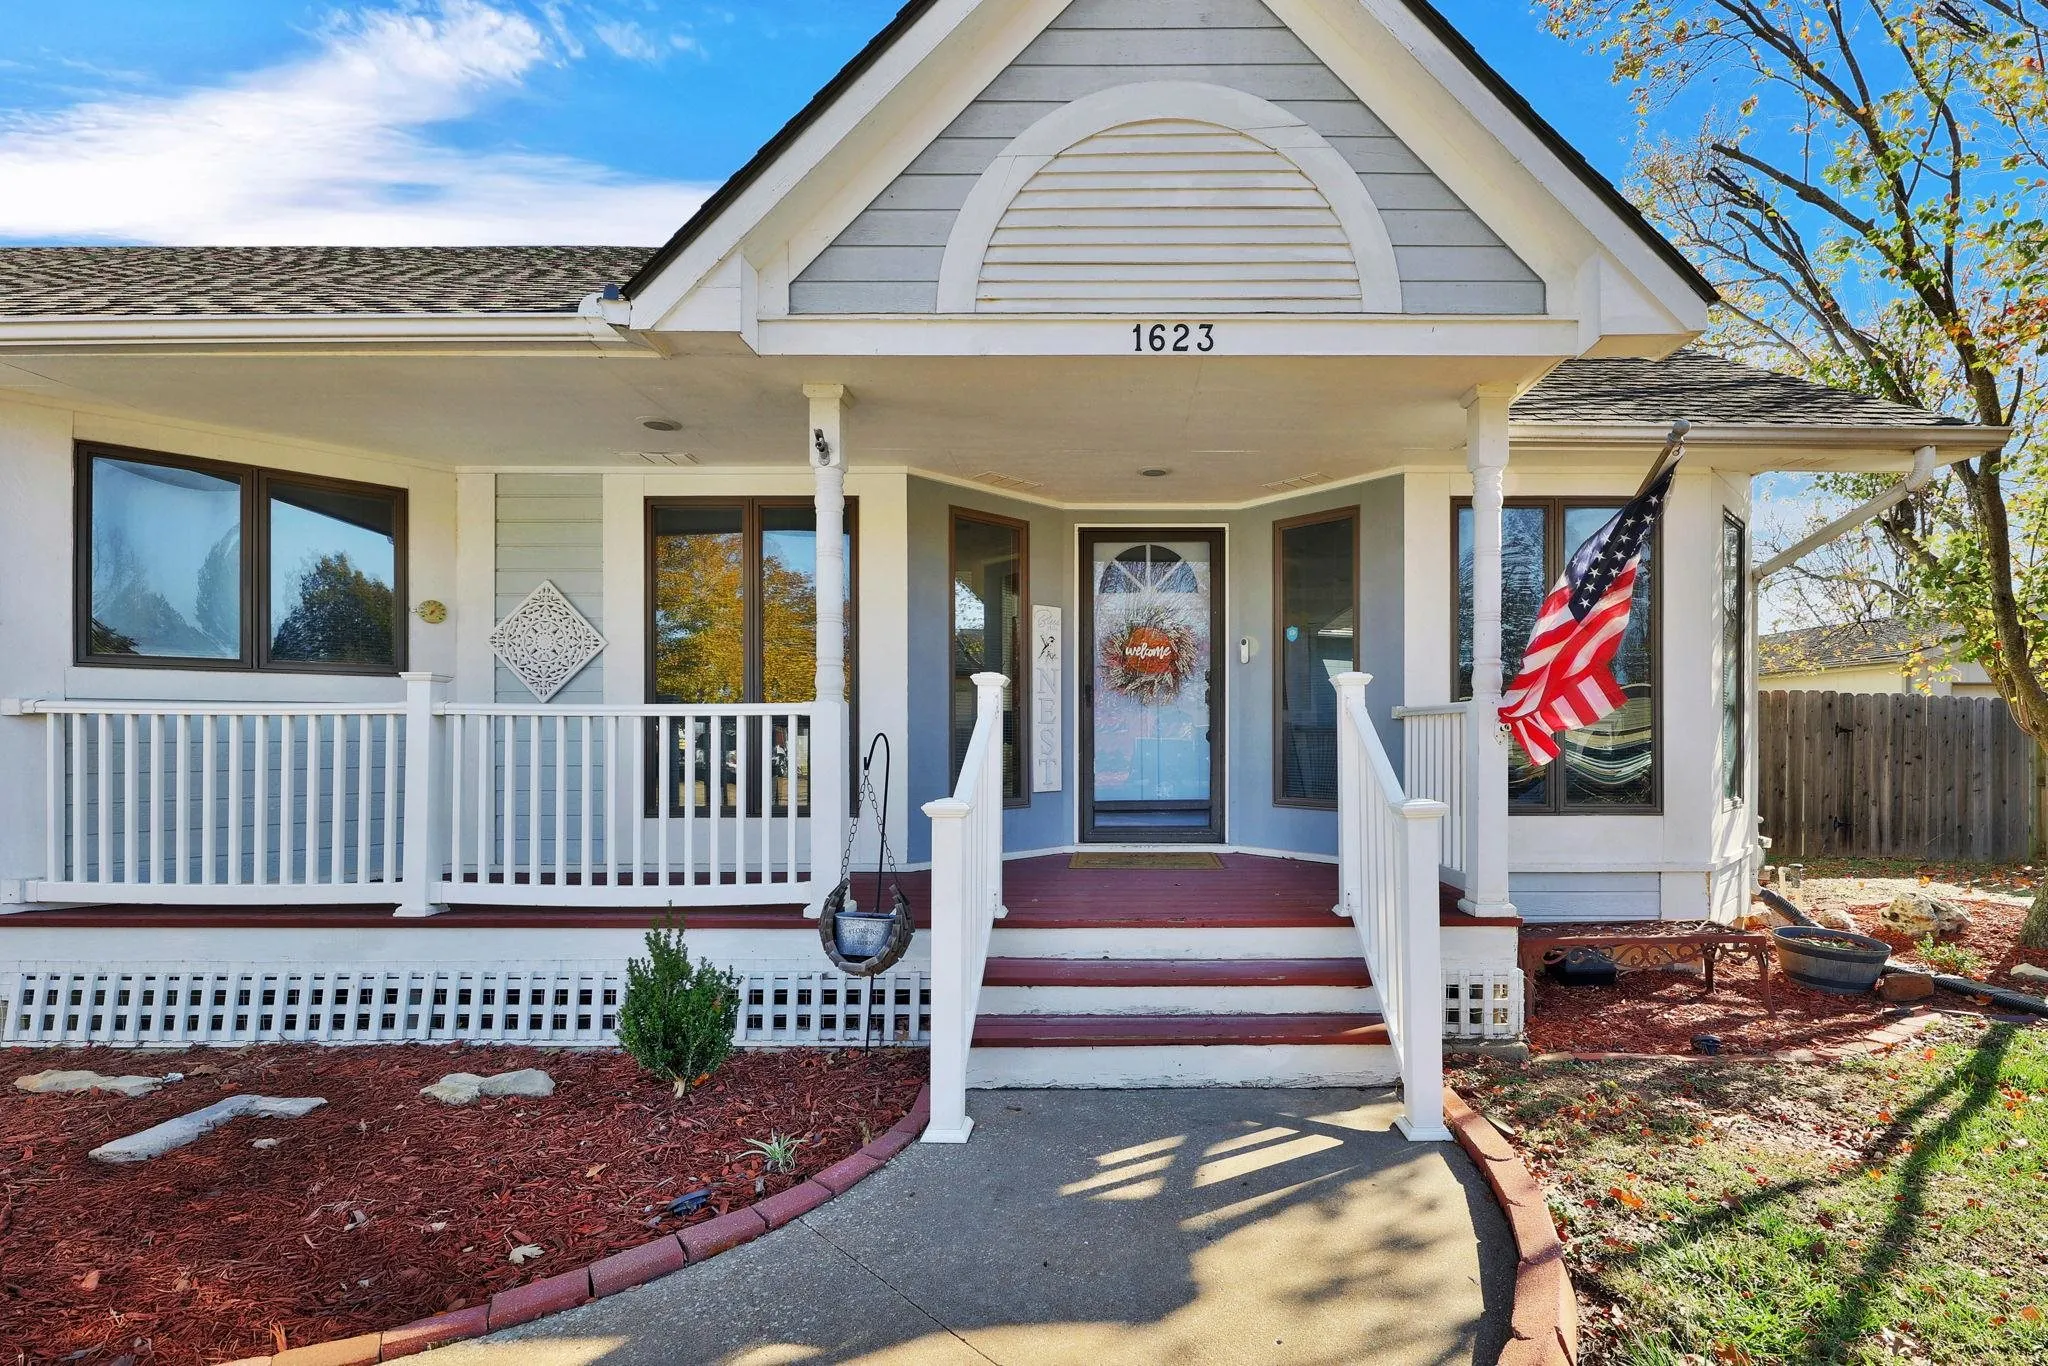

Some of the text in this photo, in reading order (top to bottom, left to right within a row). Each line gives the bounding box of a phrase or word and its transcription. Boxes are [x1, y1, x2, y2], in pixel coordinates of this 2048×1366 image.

[1132, 323, 1214, 352] 1623
[1125, 642, 1171, 660] welcome
[1036, 667, 1060, 786] NEST
